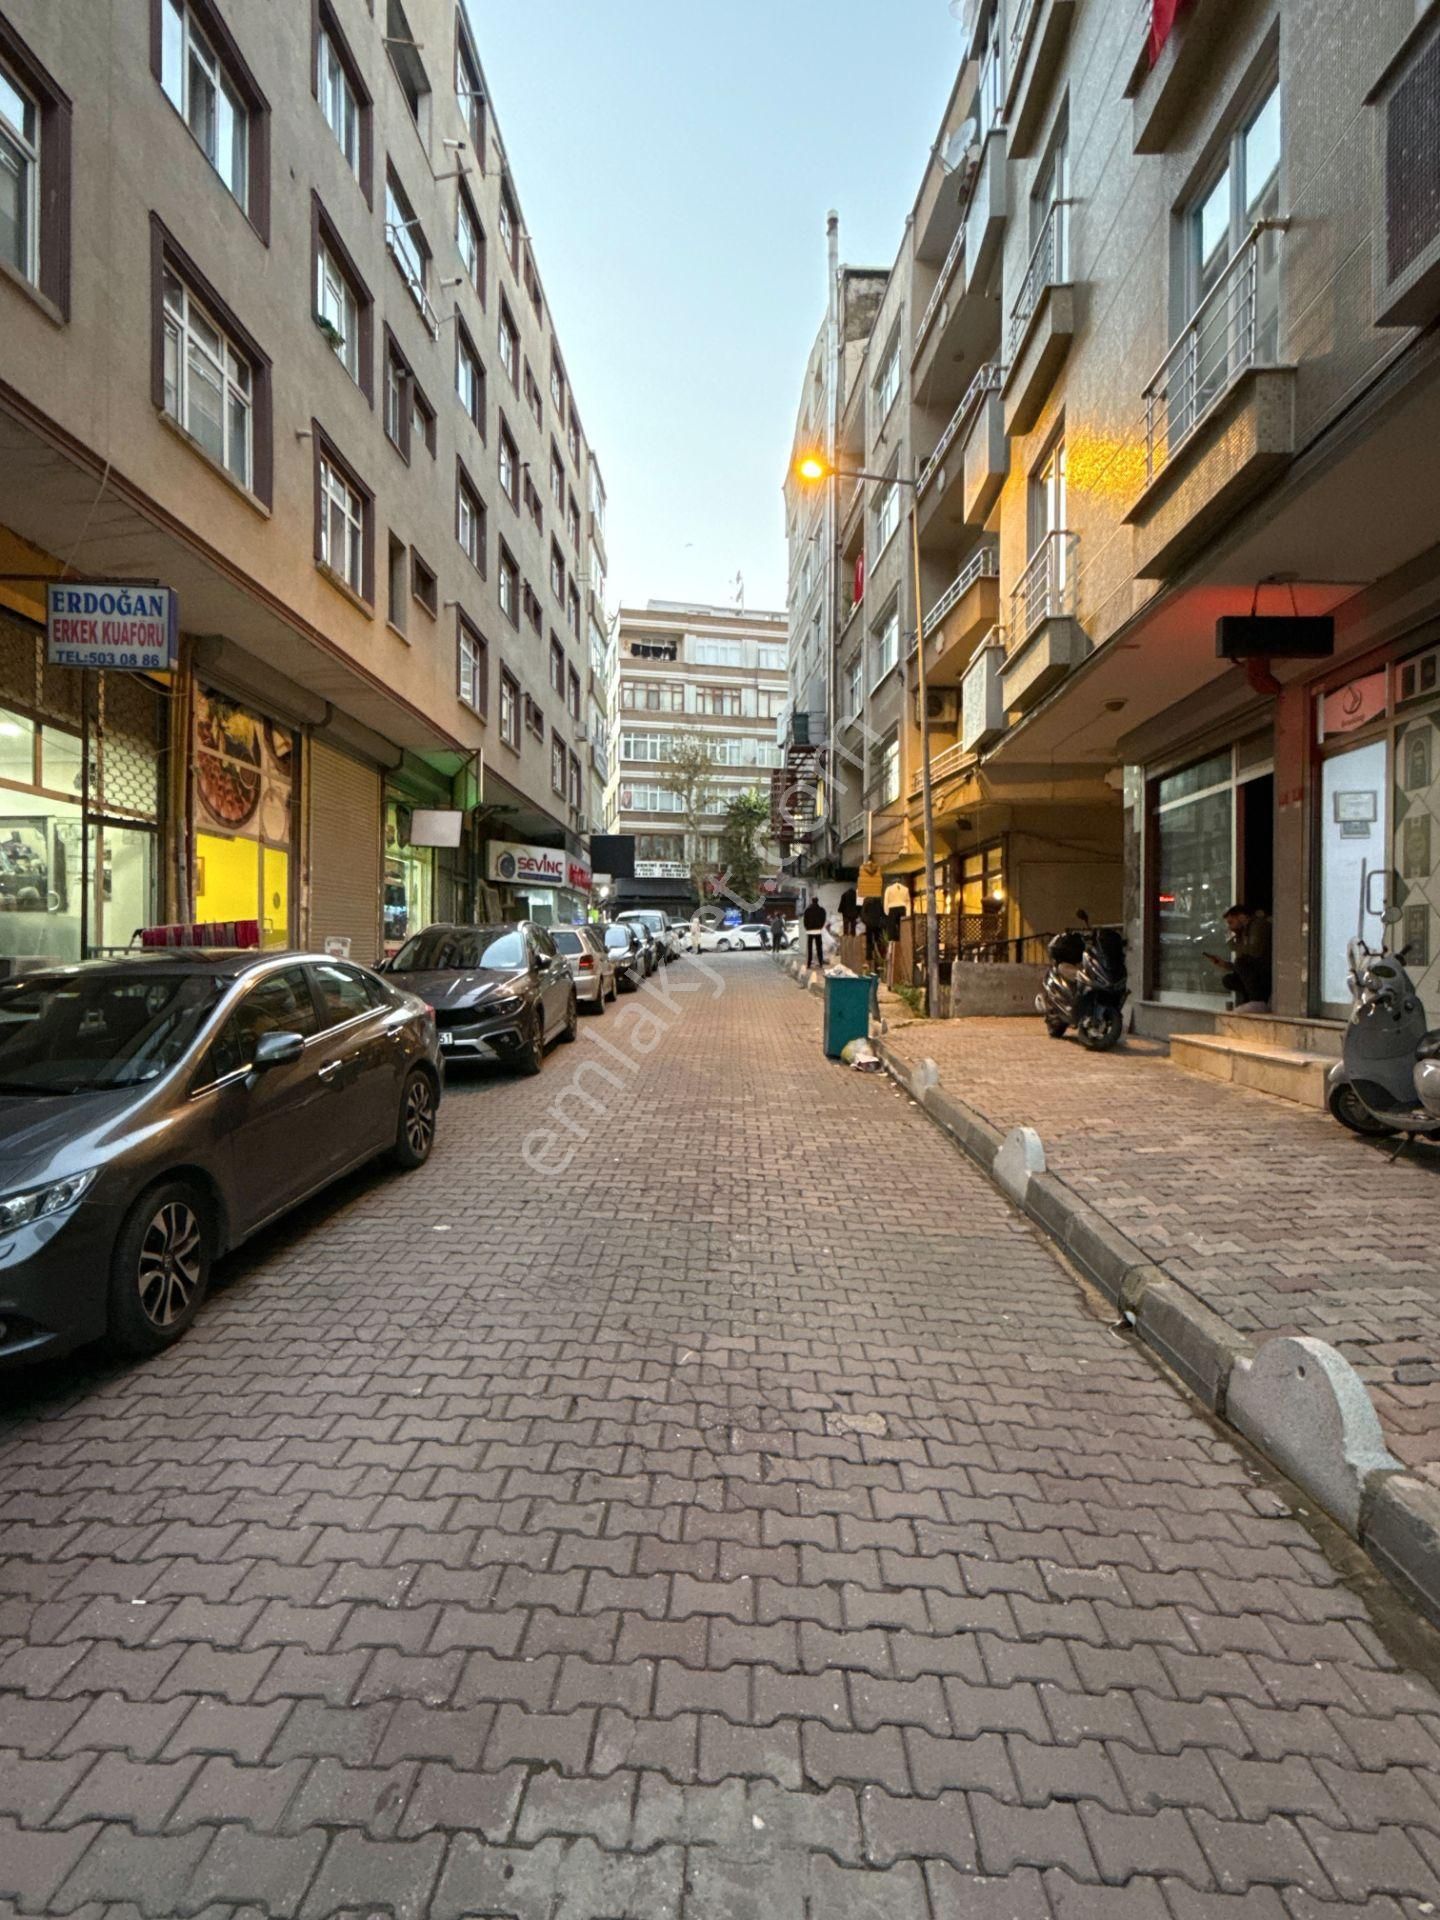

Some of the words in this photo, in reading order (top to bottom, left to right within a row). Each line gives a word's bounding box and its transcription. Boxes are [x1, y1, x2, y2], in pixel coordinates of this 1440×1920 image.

[52, 589, 164, 617] ERDOĞAN
[53, 619, 98, 645] ERKEK
[56, 651, 115, 665] TEL:503
[120, 653, 137, 666] 08
[142, 654, 160, 667] 86
